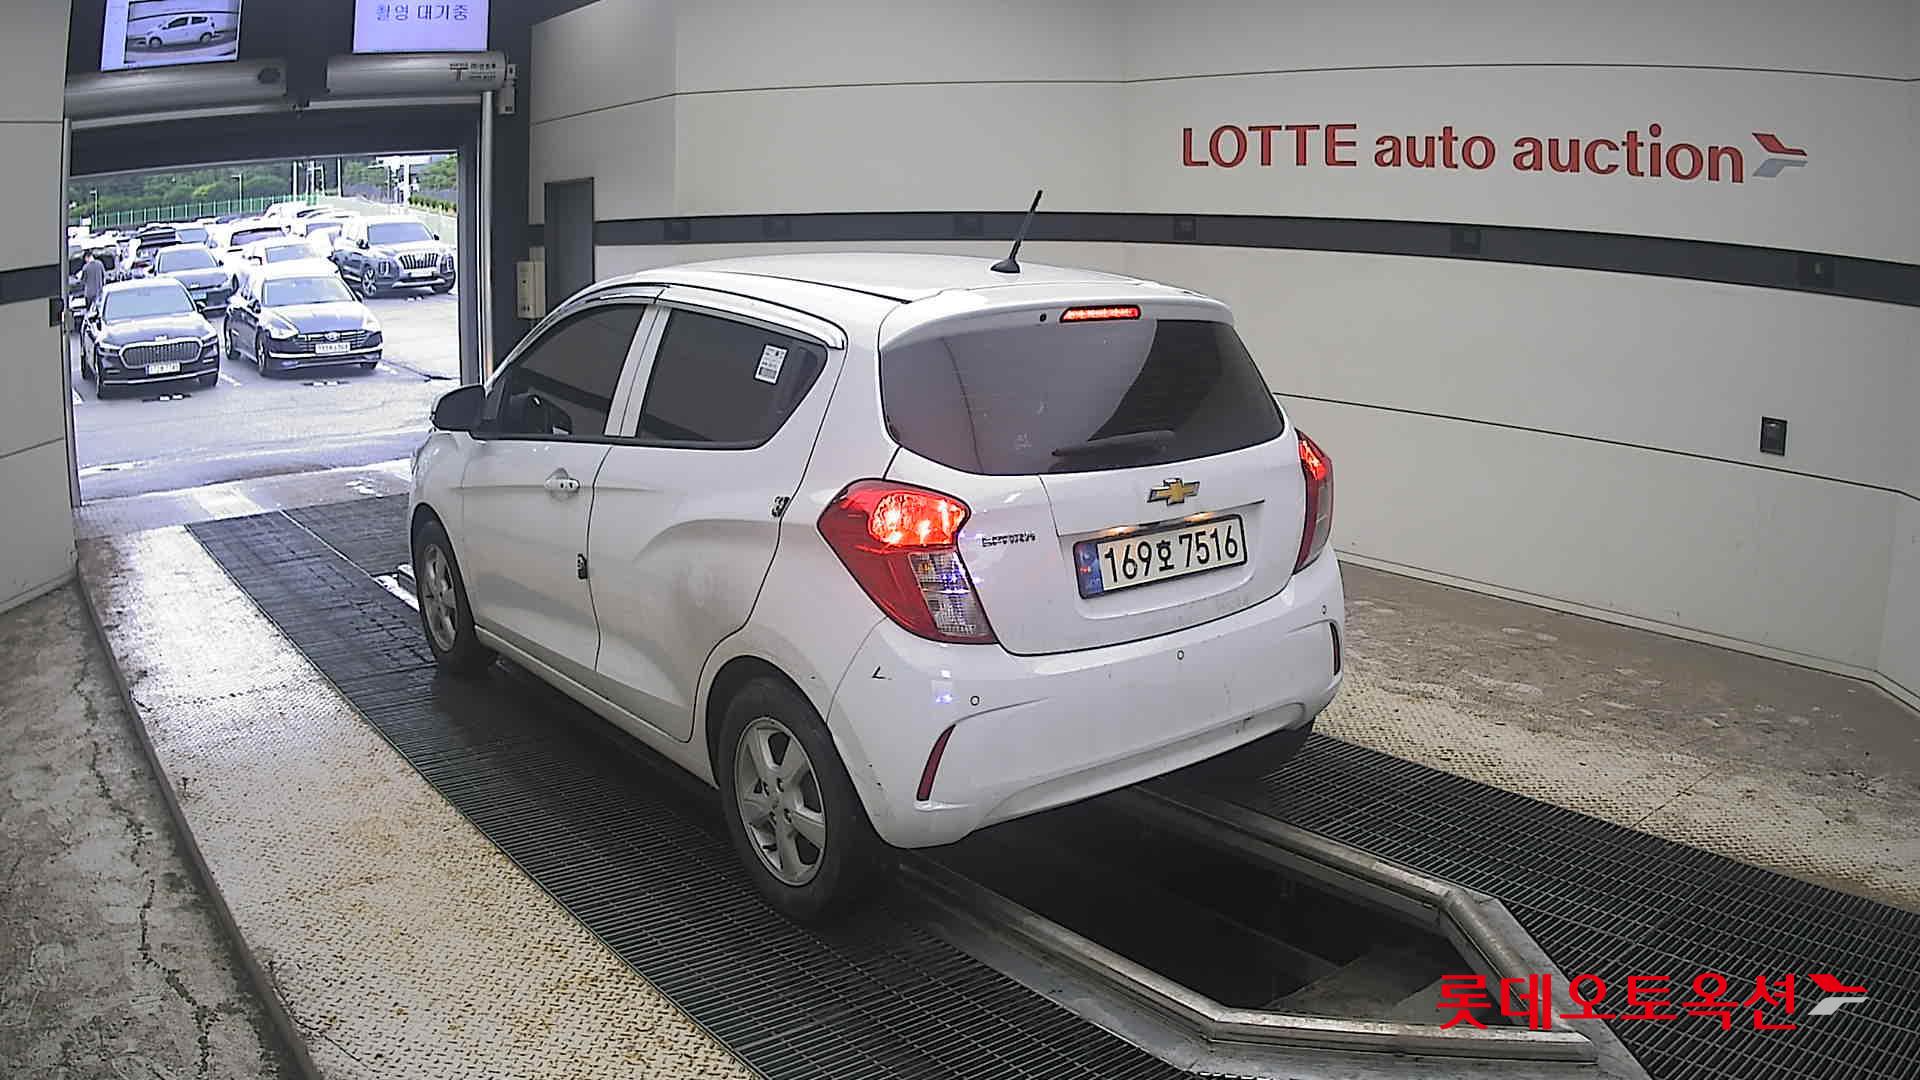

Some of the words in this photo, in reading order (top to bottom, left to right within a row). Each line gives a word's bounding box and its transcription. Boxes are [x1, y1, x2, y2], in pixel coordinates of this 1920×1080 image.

[417, 4, 469, 21] 대기중
[1182, 123, 1358, 169] LOTTE
[1373, 126, 1496, 170] auto
[1512, 123, 1745, 184] auction
